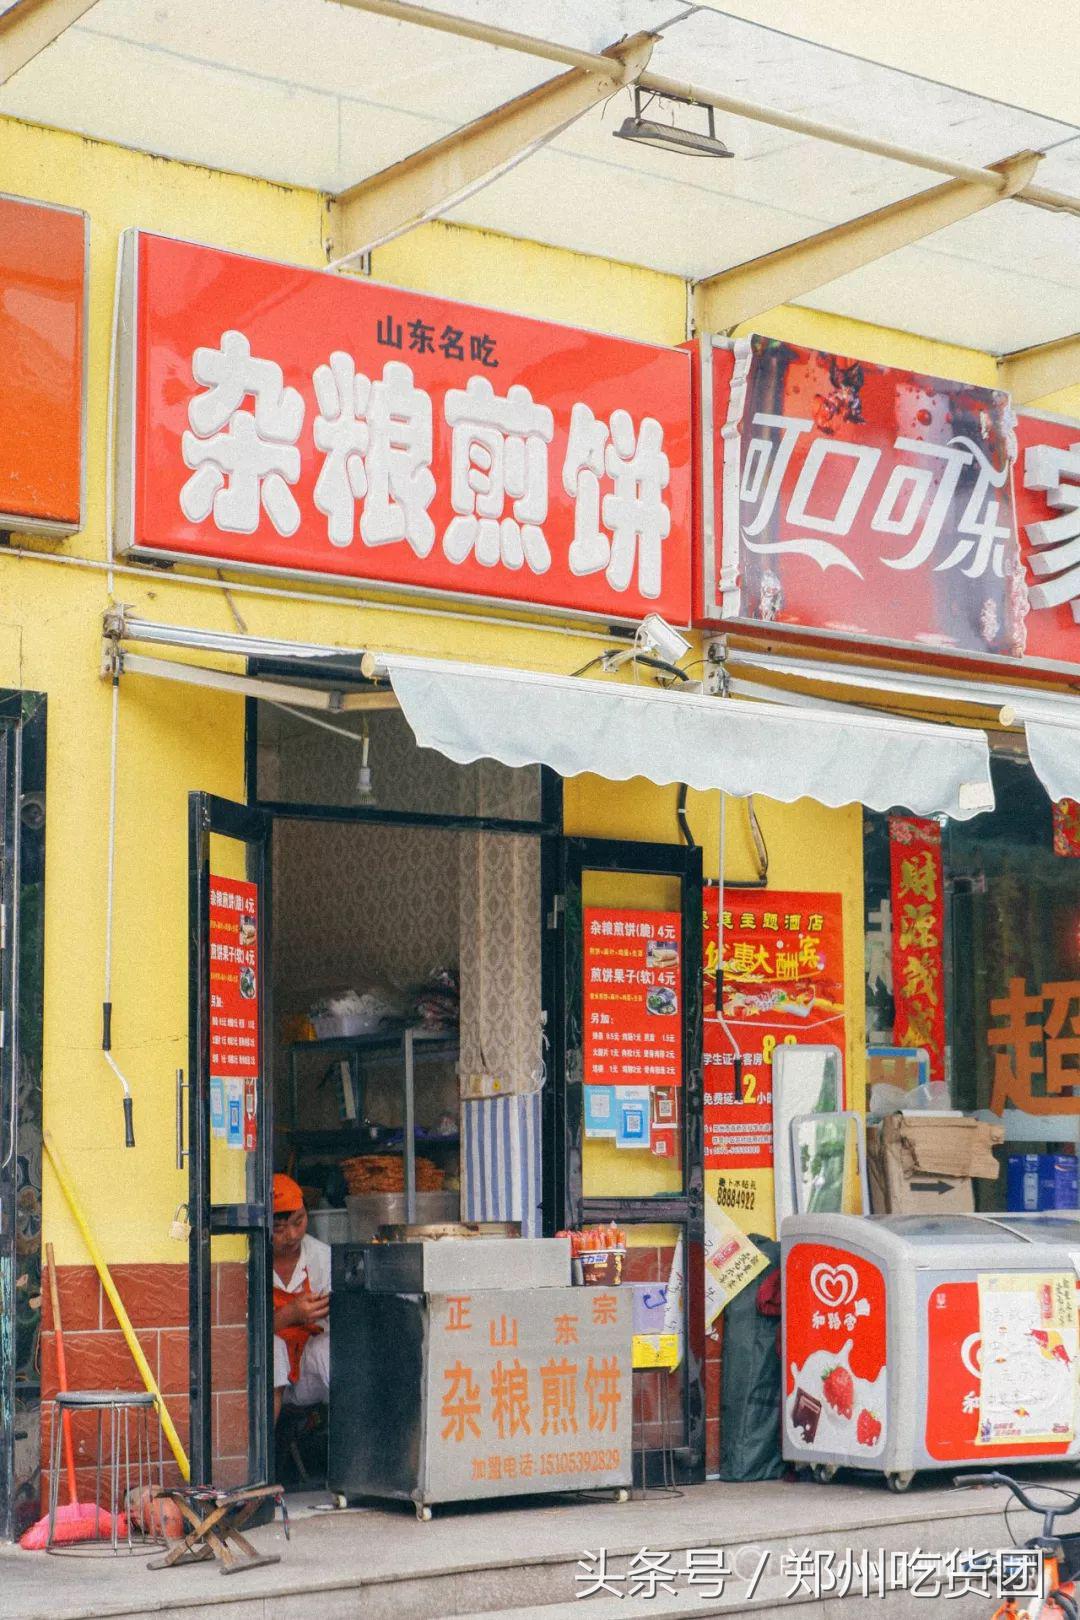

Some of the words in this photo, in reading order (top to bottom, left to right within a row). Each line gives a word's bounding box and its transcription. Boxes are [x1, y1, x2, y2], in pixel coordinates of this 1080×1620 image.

[376, 314, 499, 368] 山东名吃
[179, 329, 671, 600] 杂粮煎饼
[739, 412, 1011, 579] 可口可乐
[657, 924, 676, 939] 4元
[657, 971, 676, 986] 4元
[703, 1053, 763, 1066] 学生证客房
[987, 976, 1080, 1117] 超
[703, 1092, 743, 1105] 免费延
[743, 1074, 757, 1103] 2
[717, 1187, 756, 1211] 88884922
[812, 1310, 857, 1331] 和路雪
[441, 1355, 622, 1442] 杂粮煎饼
[471, 1453, 534, 1481] 加盟电话
